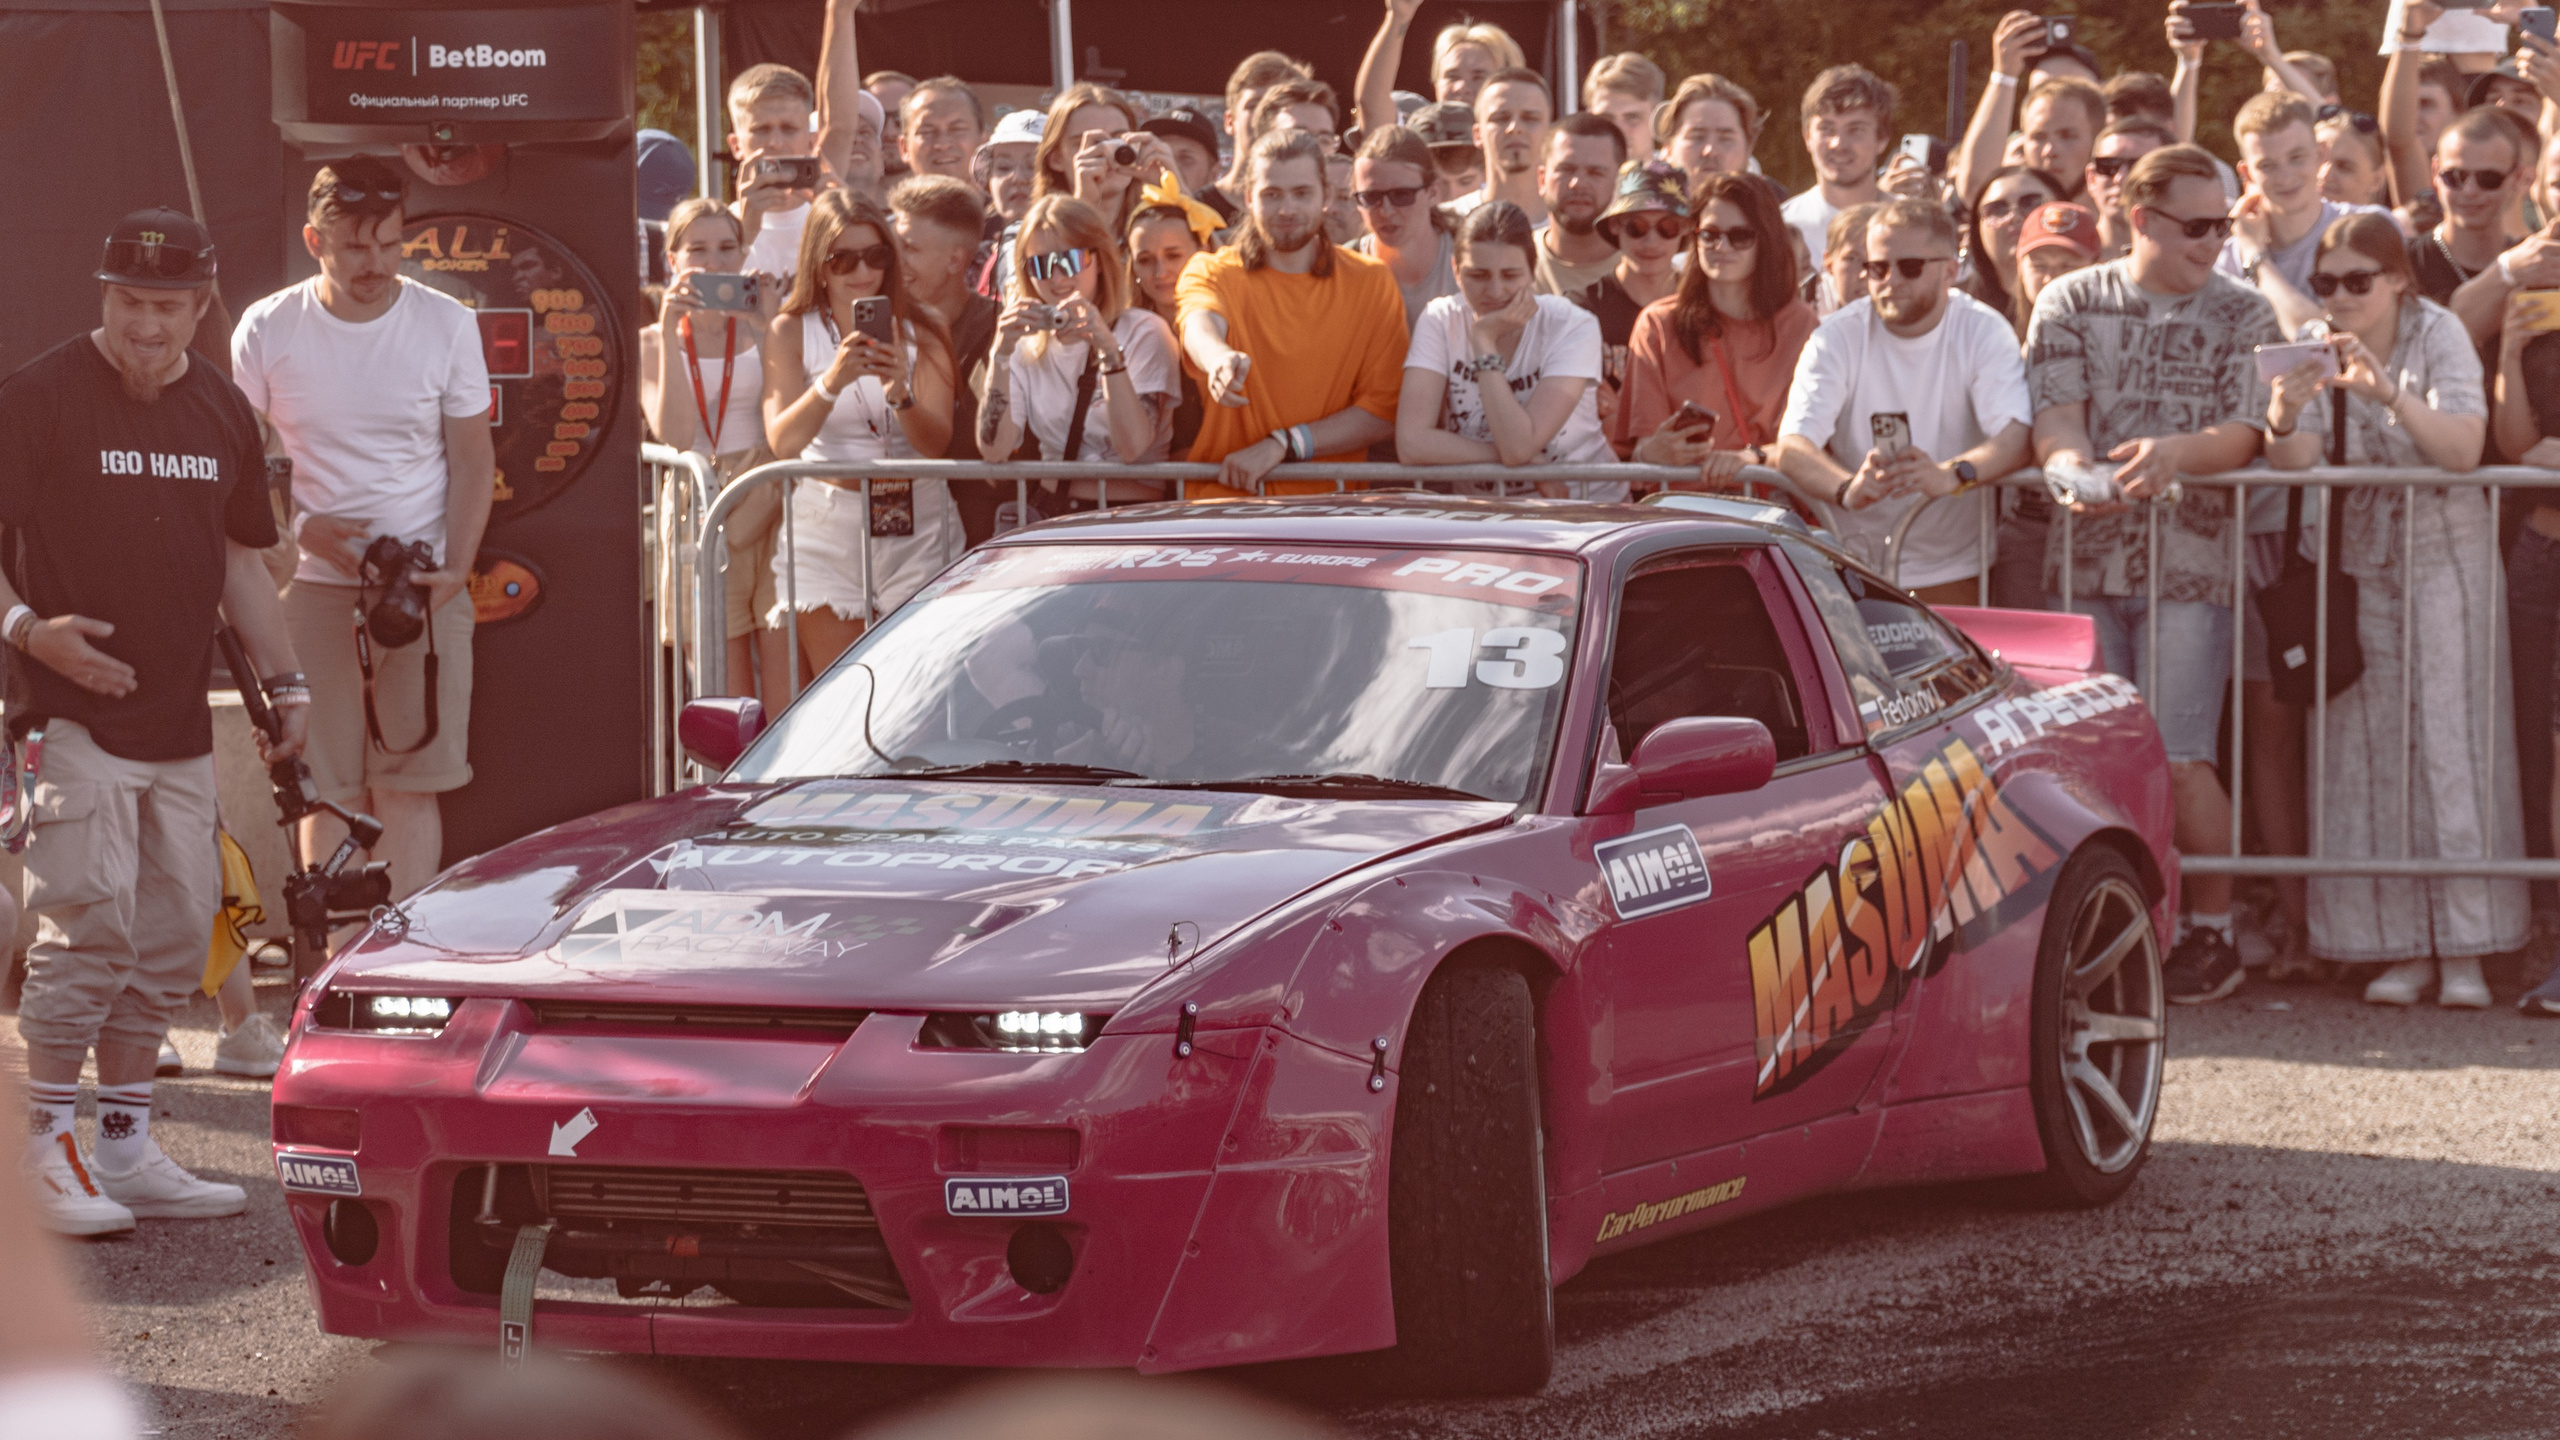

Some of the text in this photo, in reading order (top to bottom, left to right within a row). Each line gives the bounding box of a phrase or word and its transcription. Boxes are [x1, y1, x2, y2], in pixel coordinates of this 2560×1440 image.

[332, 41, 546, 70] UFC BetBoom
[349, 92, 529, 109] Официальный партнер UFC
[530, 288, 584, 313] 900
[557, 335, 603, 358] 700
[100, 450, 219, 482] !GO HARD!
[1105, 548, 1235, 568] RDS
[1271, 553, 1376, 568] EUROPE
[1392, 556, 1564, 595] PRO
[1408, 626, 1567, 690] 13
[742, 793, 1213, 836] MASUMA
[694, 831, 1166, 852] AUTO SPARE PARTS
[1609, 841, 1702, 903] AIMOL
[653, 909, 832, 938] ADM
[1747, 737, 2062, 1097] MASUMA
[628, 935, 869, 958] RACEWAY
[281, 1161, 356, 1189] AIMOL
[951, 1186, 1064, 1209] AIMOL
